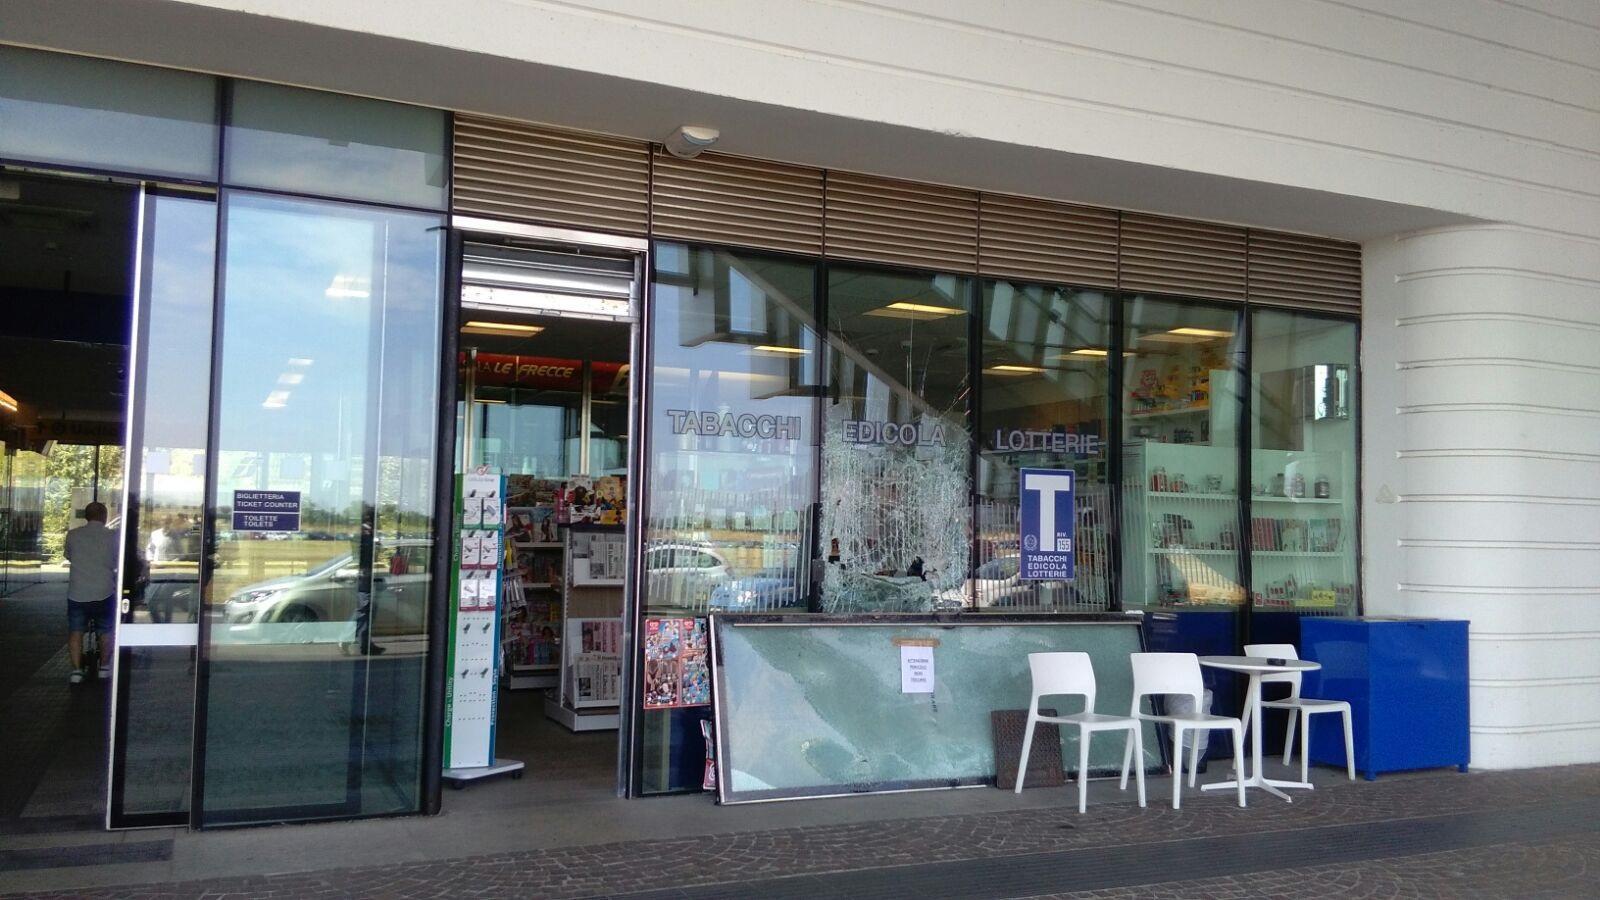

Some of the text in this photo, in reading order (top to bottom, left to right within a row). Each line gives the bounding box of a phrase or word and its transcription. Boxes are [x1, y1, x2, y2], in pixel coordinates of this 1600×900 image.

[493, 362, 514, 374] LE
[518, 364, 575, 378] FRECCE
[667, 409, 801, 440] TABACCHI
[842, 419, 946, 447] EDICOLA
[996, 429, 1099, 455] LOTTERIE
[1025, 474, 1070, 551] T
